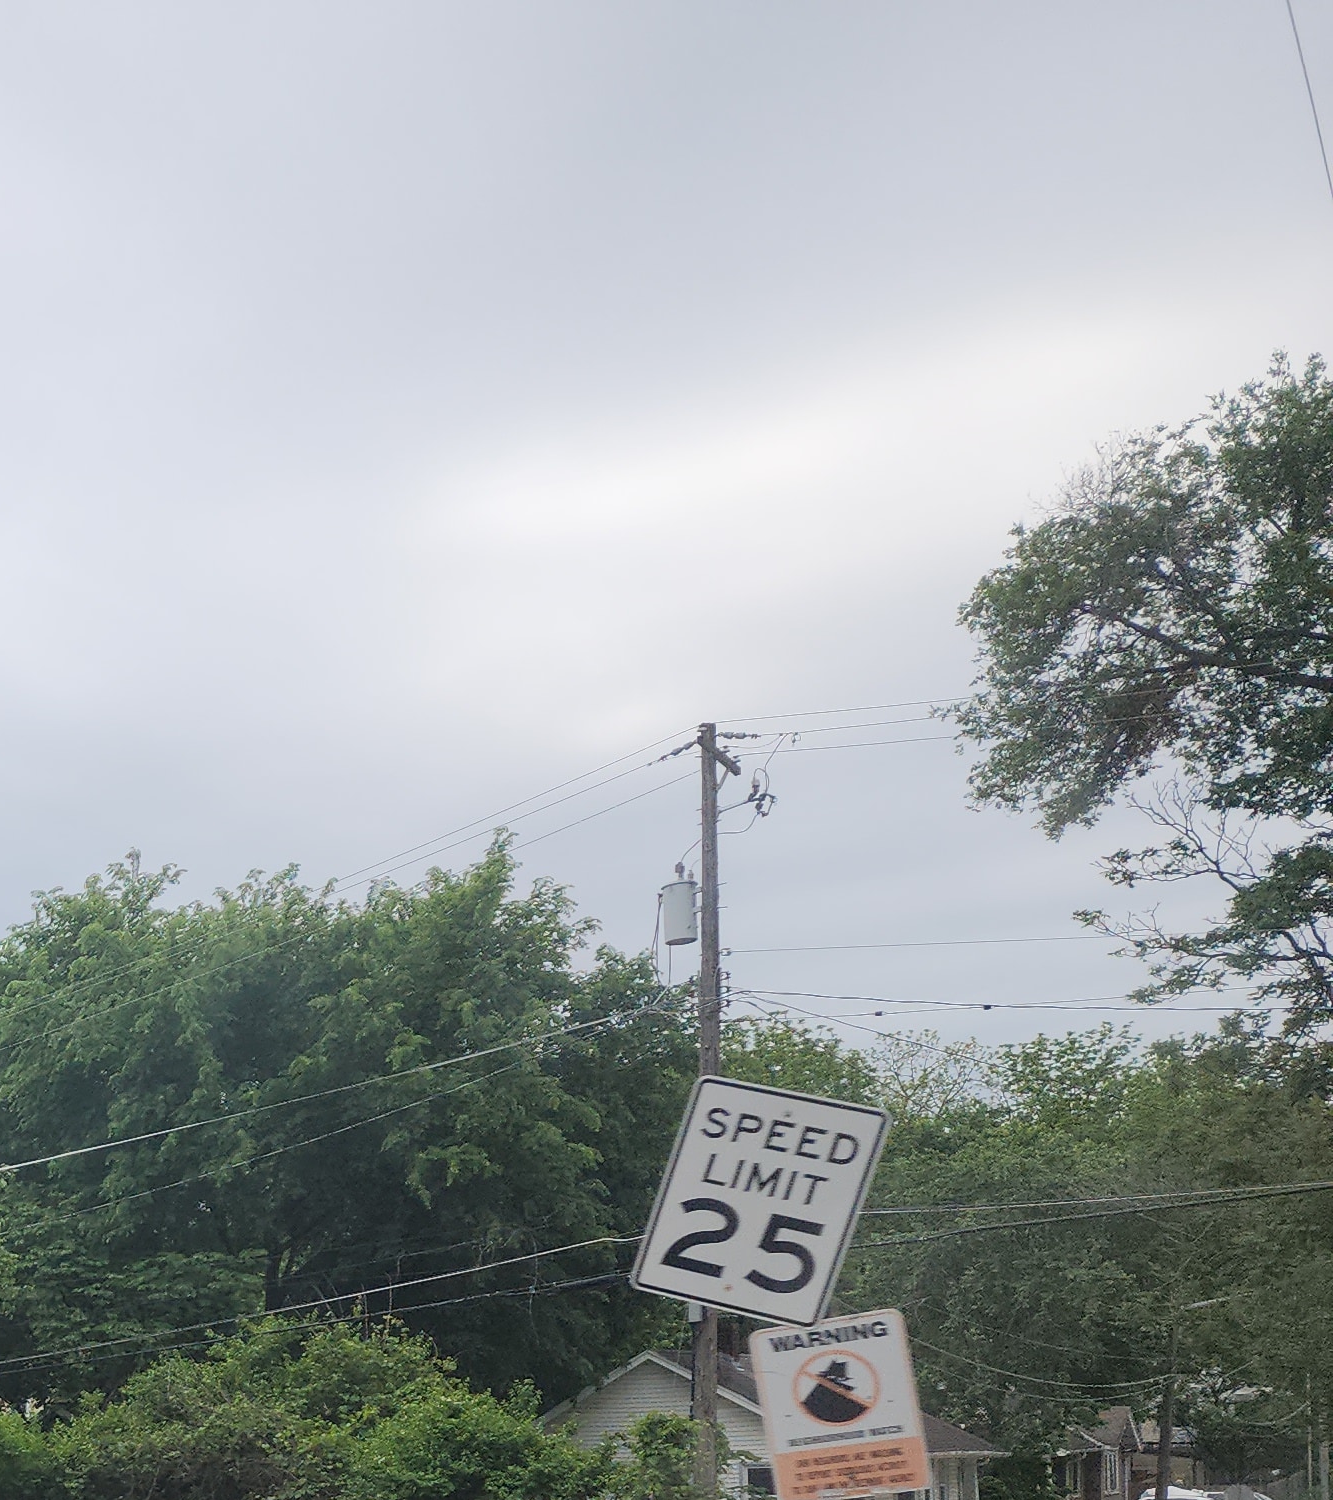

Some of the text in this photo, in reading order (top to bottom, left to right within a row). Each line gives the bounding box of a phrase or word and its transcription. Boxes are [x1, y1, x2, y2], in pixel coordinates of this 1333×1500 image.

[700, 1107, 860, 1166] SPEED
[701, 1153, 830, 1205] LIMIT
[660, 1197, 826, 1294] 25
[769, 1320, 889, 1352] WARNING
